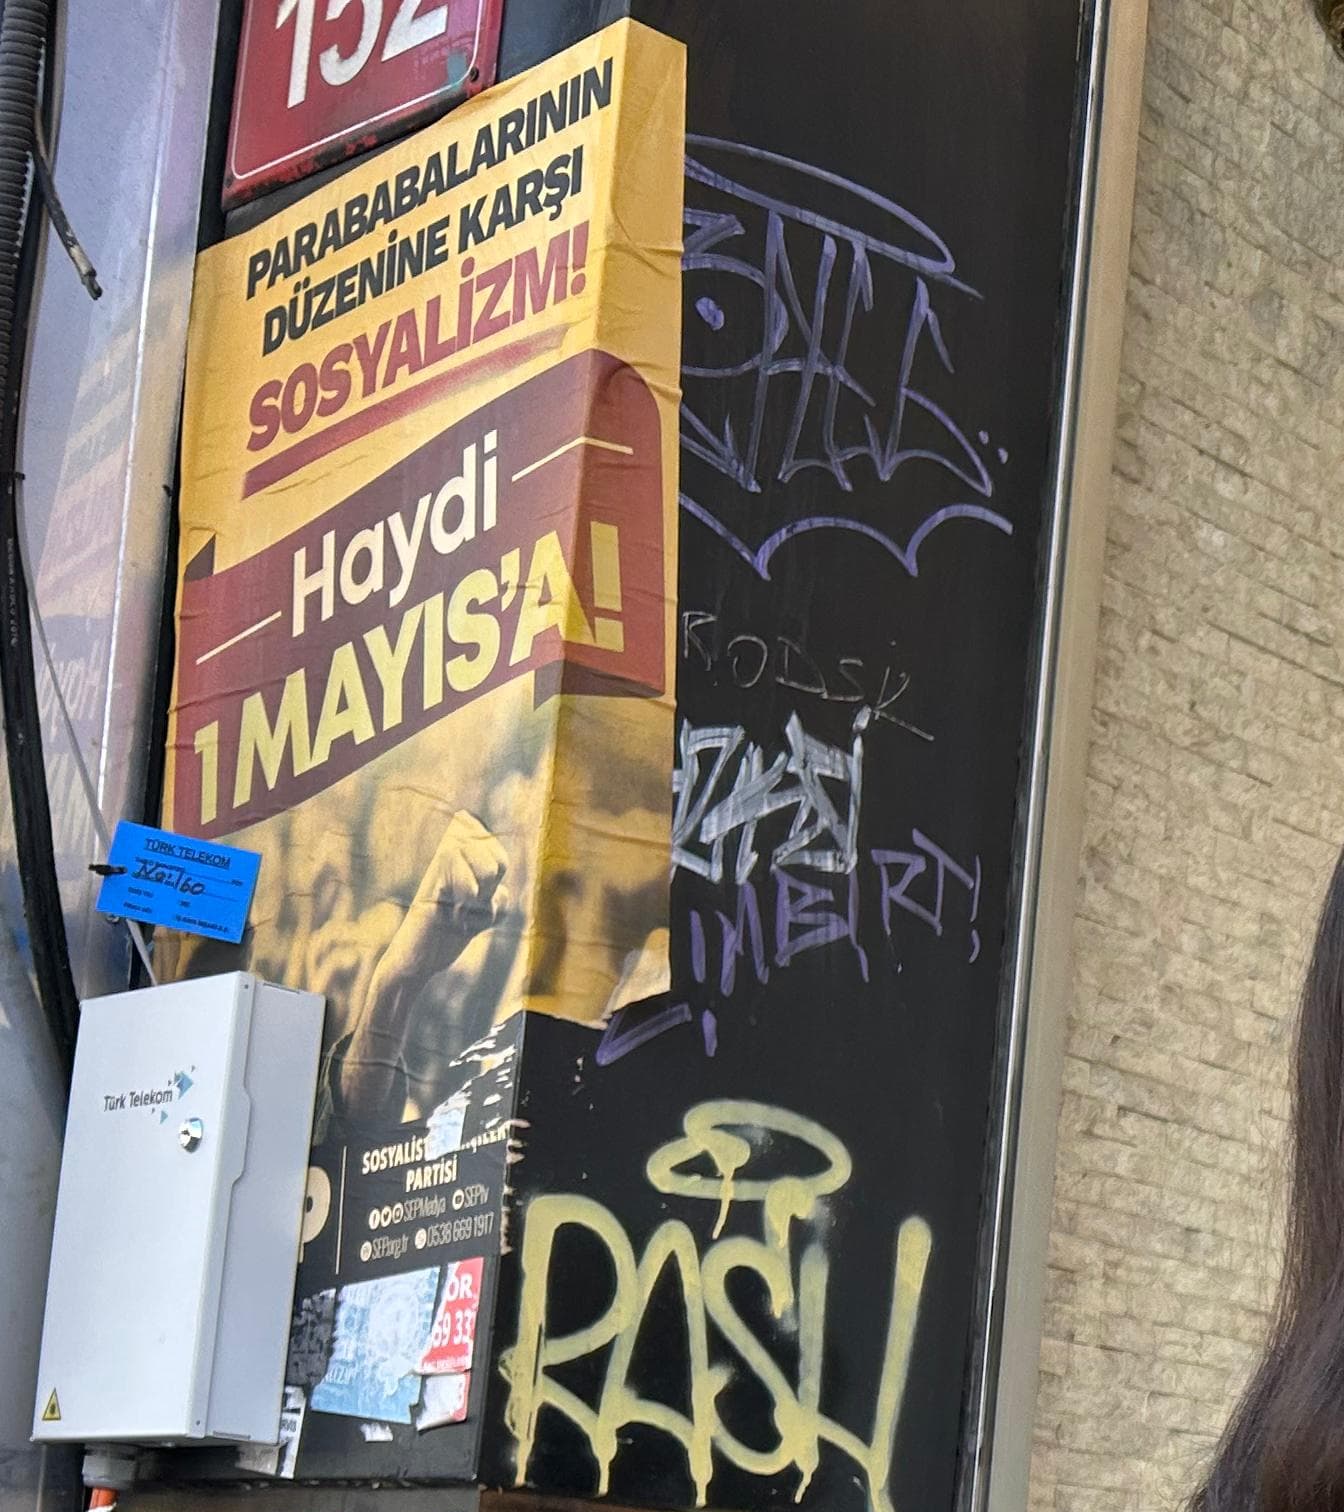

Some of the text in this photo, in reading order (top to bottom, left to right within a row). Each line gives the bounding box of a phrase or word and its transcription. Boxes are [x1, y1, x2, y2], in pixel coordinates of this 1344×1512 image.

[275, 0, 447, 109] 152
[246, 57, 614, 300] PARABABALARININ
[262, 145, 584, 357] DÜZENİNE KARŞI
[246, 220, 589, 453] SOSYALİZM!
[291, 429, 497, 639] Haydi
[194, 719, 219, 825] 1
[232, 520, 626, 810] MAYIS'A!
[145, 838, 177, 855] TÜRK
[177, 846, 231, 870] TELEKOM
[104, 1089, 173, 1112] Türk Telekom
[405, 1154, 457, 1193] PARTİSİ
